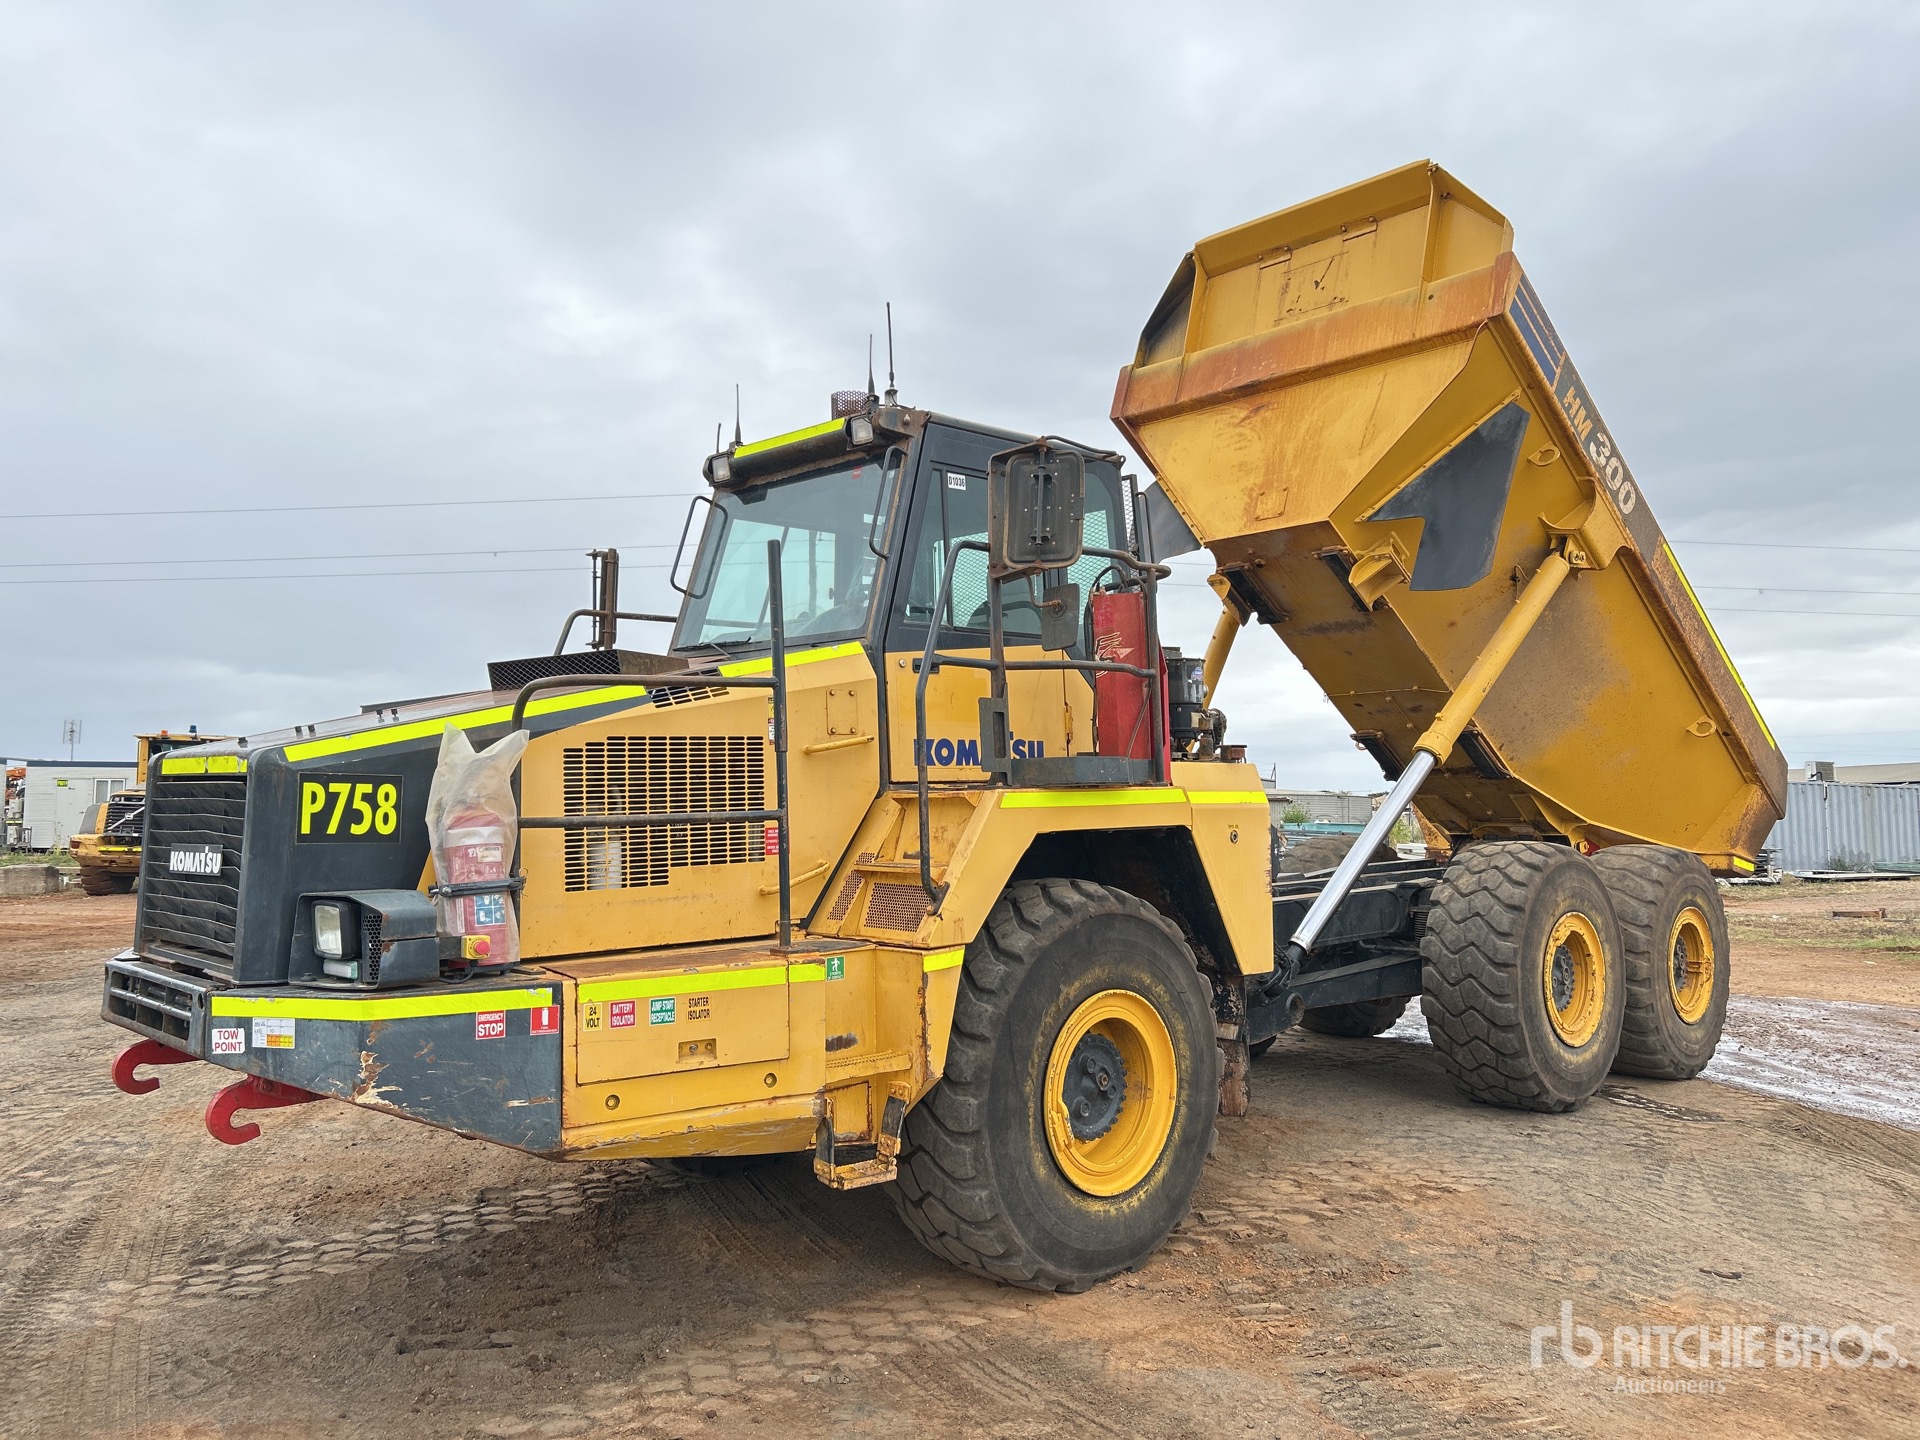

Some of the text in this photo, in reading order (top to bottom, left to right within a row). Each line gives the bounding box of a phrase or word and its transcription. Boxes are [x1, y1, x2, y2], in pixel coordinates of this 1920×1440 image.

[1563, 386, 1636, 515] HM 300
[914, 731, 1044, 767] KOMSU
[301, 782, 397, 835] P758
[169, 846, 222, 874] KOMATSU
[651, 1000, 674, 1012] JUMP START
[688, 997, 709, 1008] STARTER
[589, 1006, 597, 1016] 24
[612, 1003, 633, 1015] BATTERY
[687, 1009, 710, 1020] ISOLATOR
[478, 1012, 504, 1022] EMERGENCY
[586, 1017, 600, 1028] VOLT
[611, 1014, 634, 1026] ISOLATOR
[651, 1011, 675, 1022] RECEPTACLE
[217, 1029, 239, 1041] TOW
[478, 1022, 504, 1037] STOP
[214, 1041, 242, 1052] POINT
